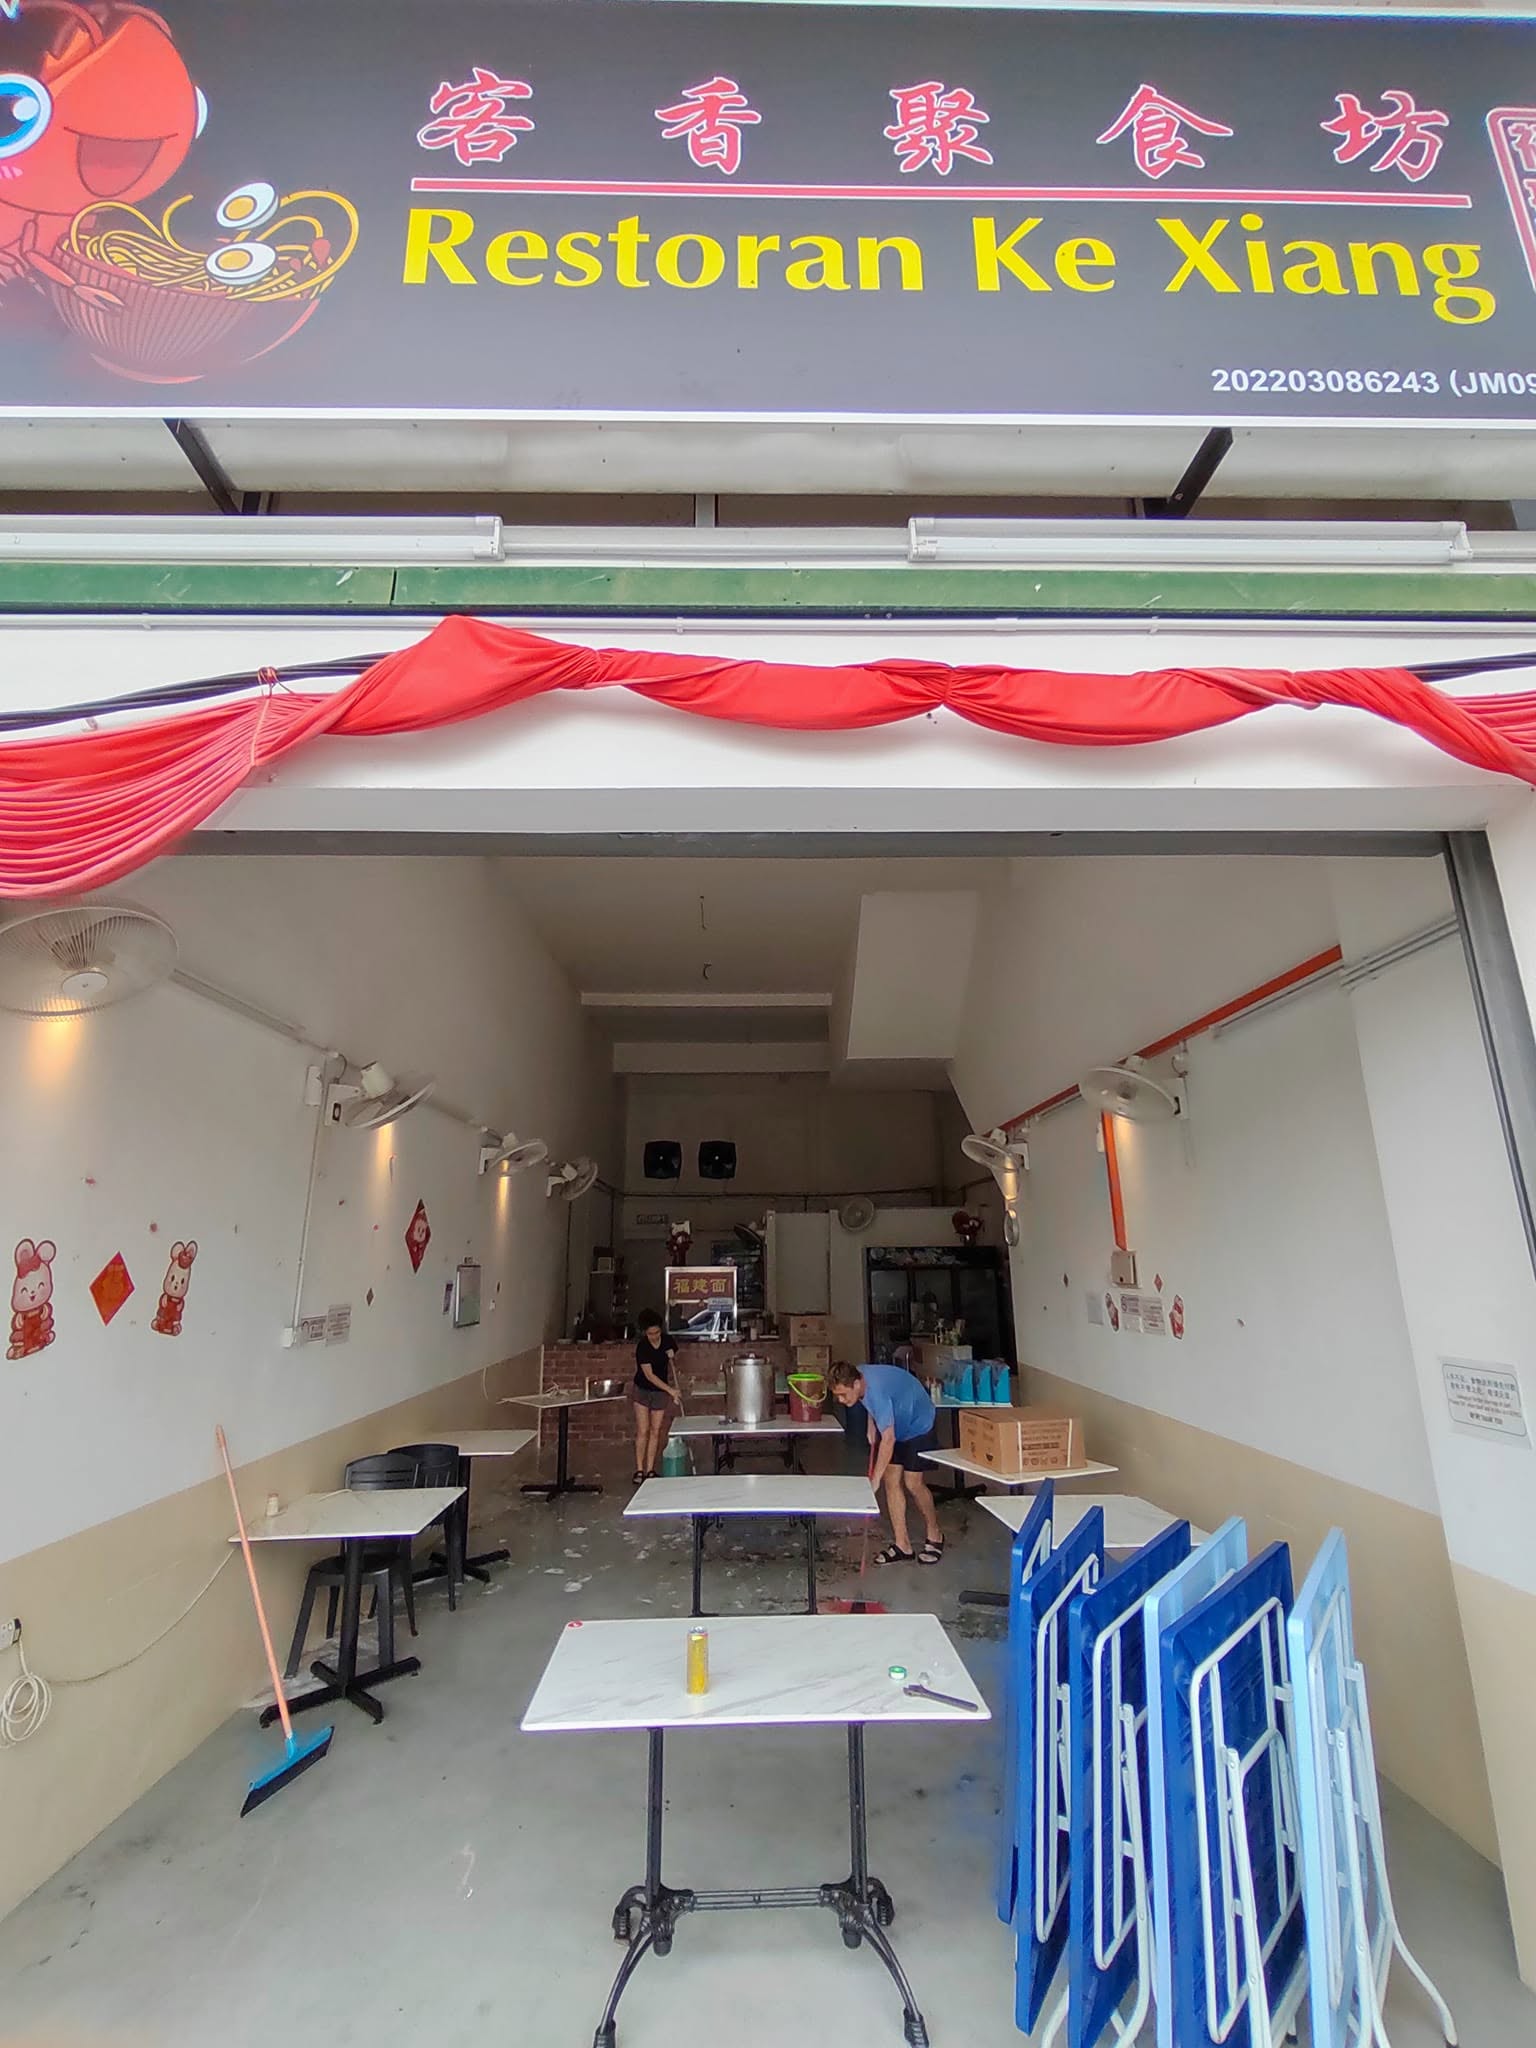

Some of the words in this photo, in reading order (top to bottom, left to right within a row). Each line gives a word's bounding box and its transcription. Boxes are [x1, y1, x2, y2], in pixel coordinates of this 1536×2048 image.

[416, 67, 1450, 182] 客香聚食坊
[402, 207, 924, 291] Restoran
[972, 215, 1116, 292] Ke
[1155, 212, 1496, 324] Xiang
[1210, 368, 1441, 394] 202203086243
